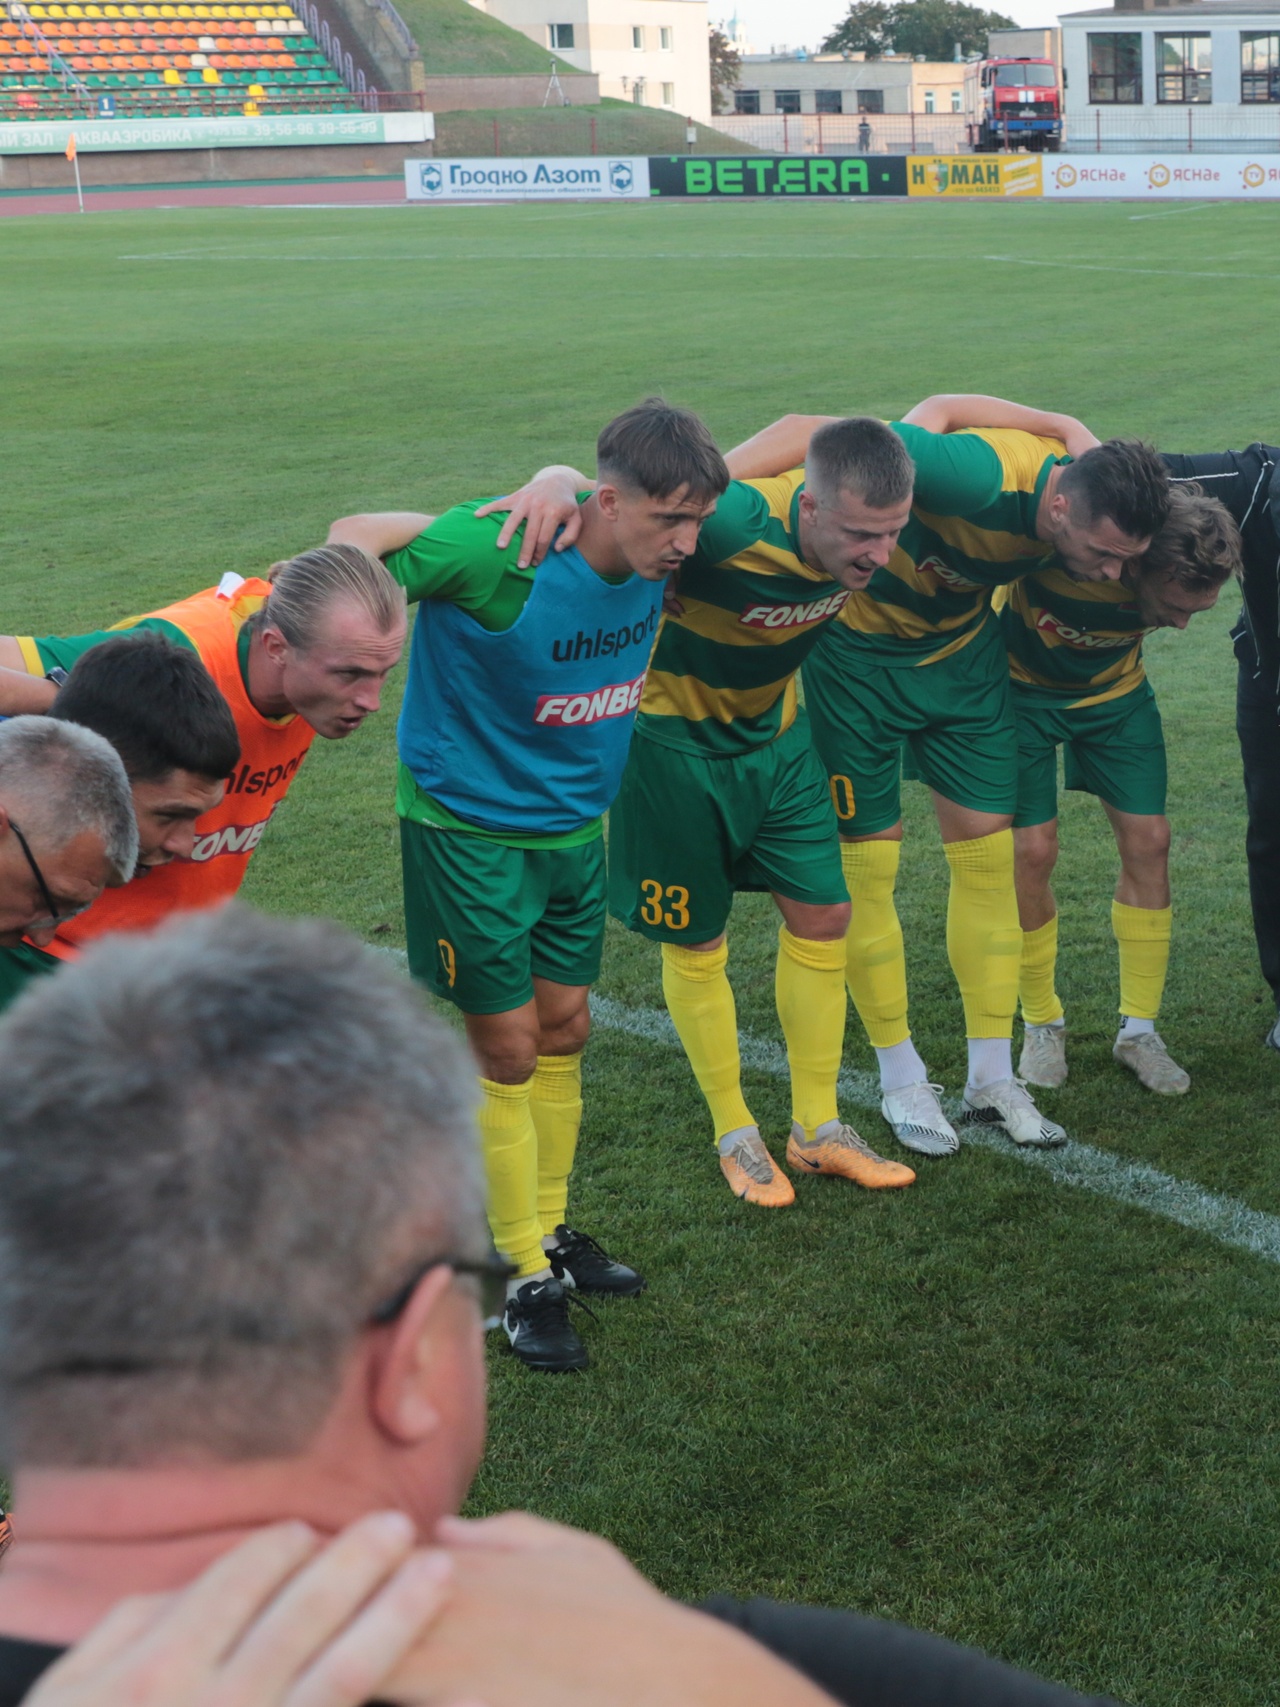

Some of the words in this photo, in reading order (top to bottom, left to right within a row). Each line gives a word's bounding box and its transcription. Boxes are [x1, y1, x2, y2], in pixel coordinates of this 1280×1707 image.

[22, 132, 53, 147] ЗАЛ
[449, 164, 528, 186] Гродно
[533, 164, 601, 184] Азот
[685, 159, 869, 193] BETERA
[741, 591, 852, 628] FONBE
[552, 604, 657, 663] uhlsport
[190, 810, 274, 862] ONB
[640, 878, 690, 930] 33
